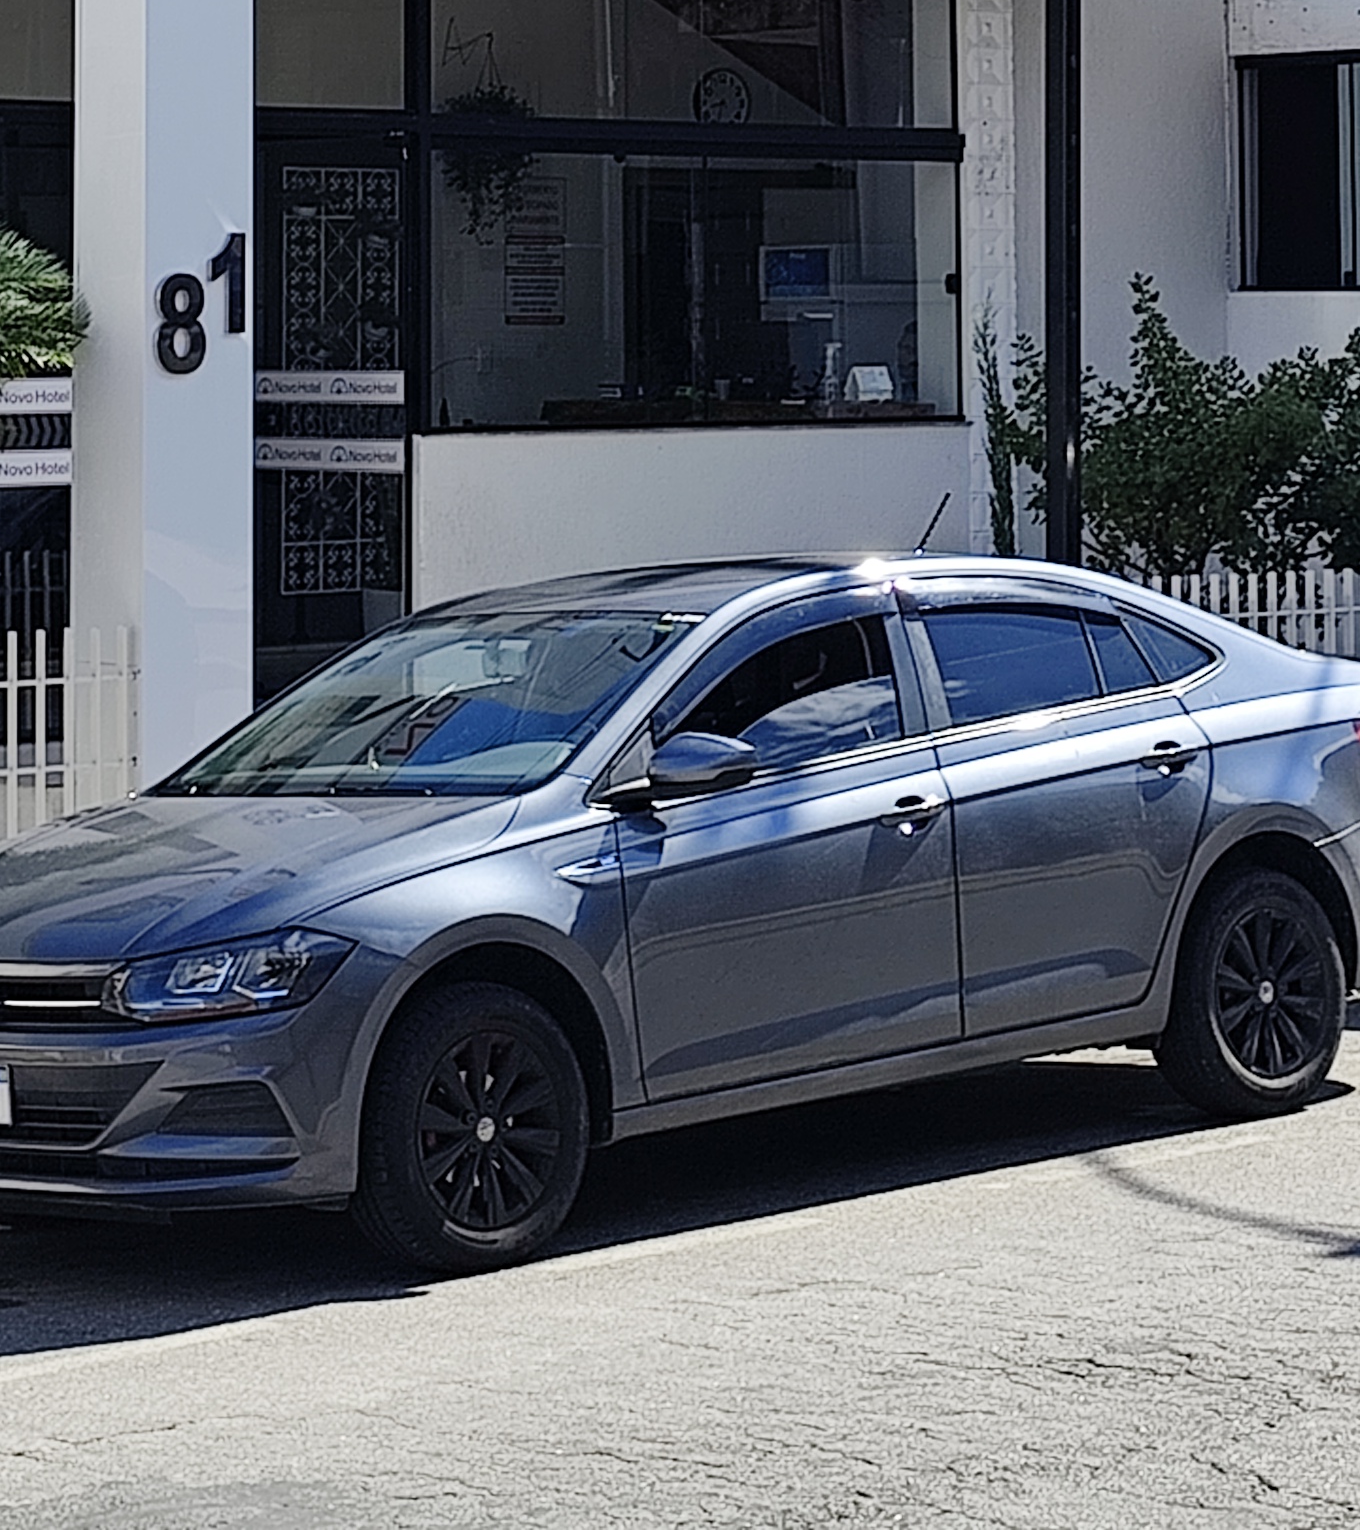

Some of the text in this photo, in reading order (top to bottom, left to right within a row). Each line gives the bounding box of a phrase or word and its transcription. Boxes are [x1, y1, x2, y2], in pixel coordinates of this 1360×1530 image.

[155, 232, 246, 375] 81
[35, 390, 70, 404] Hotel
[35, 463, 70, 476] Hotel
